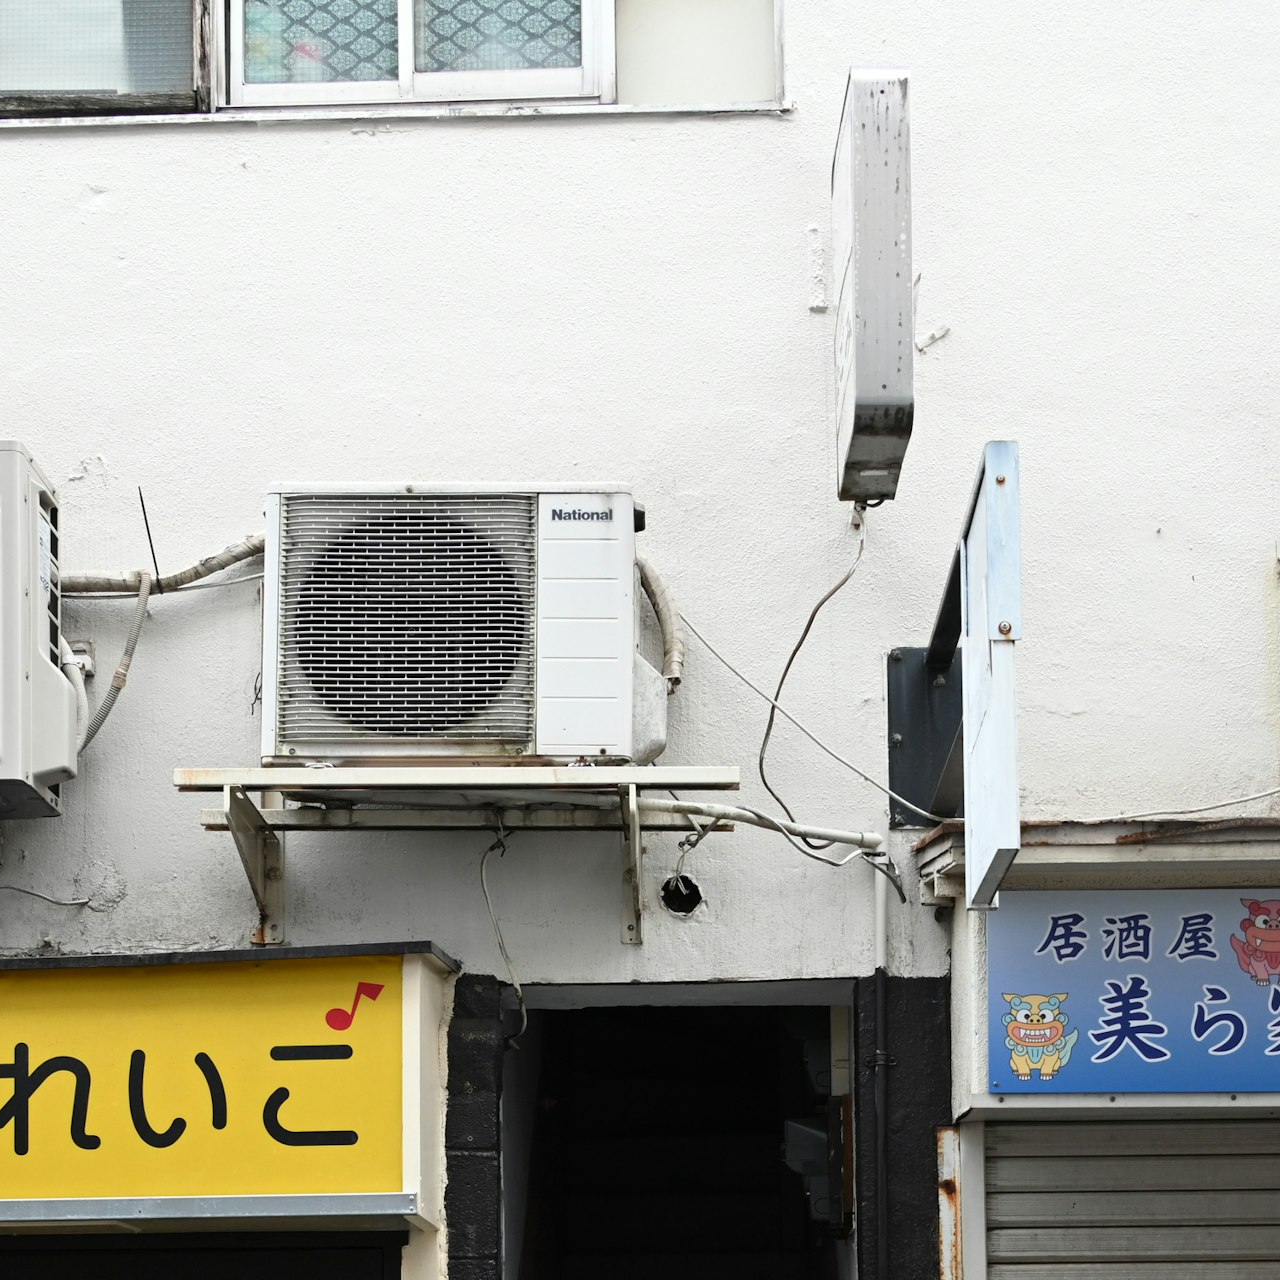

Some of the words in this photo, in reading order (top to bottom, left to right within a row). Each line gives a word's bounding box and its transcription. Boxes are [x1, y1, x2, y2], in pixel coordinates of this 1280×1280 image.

[551, 508, 613, 521] National
[1036, 913, 1219, 961] 居酒屋
